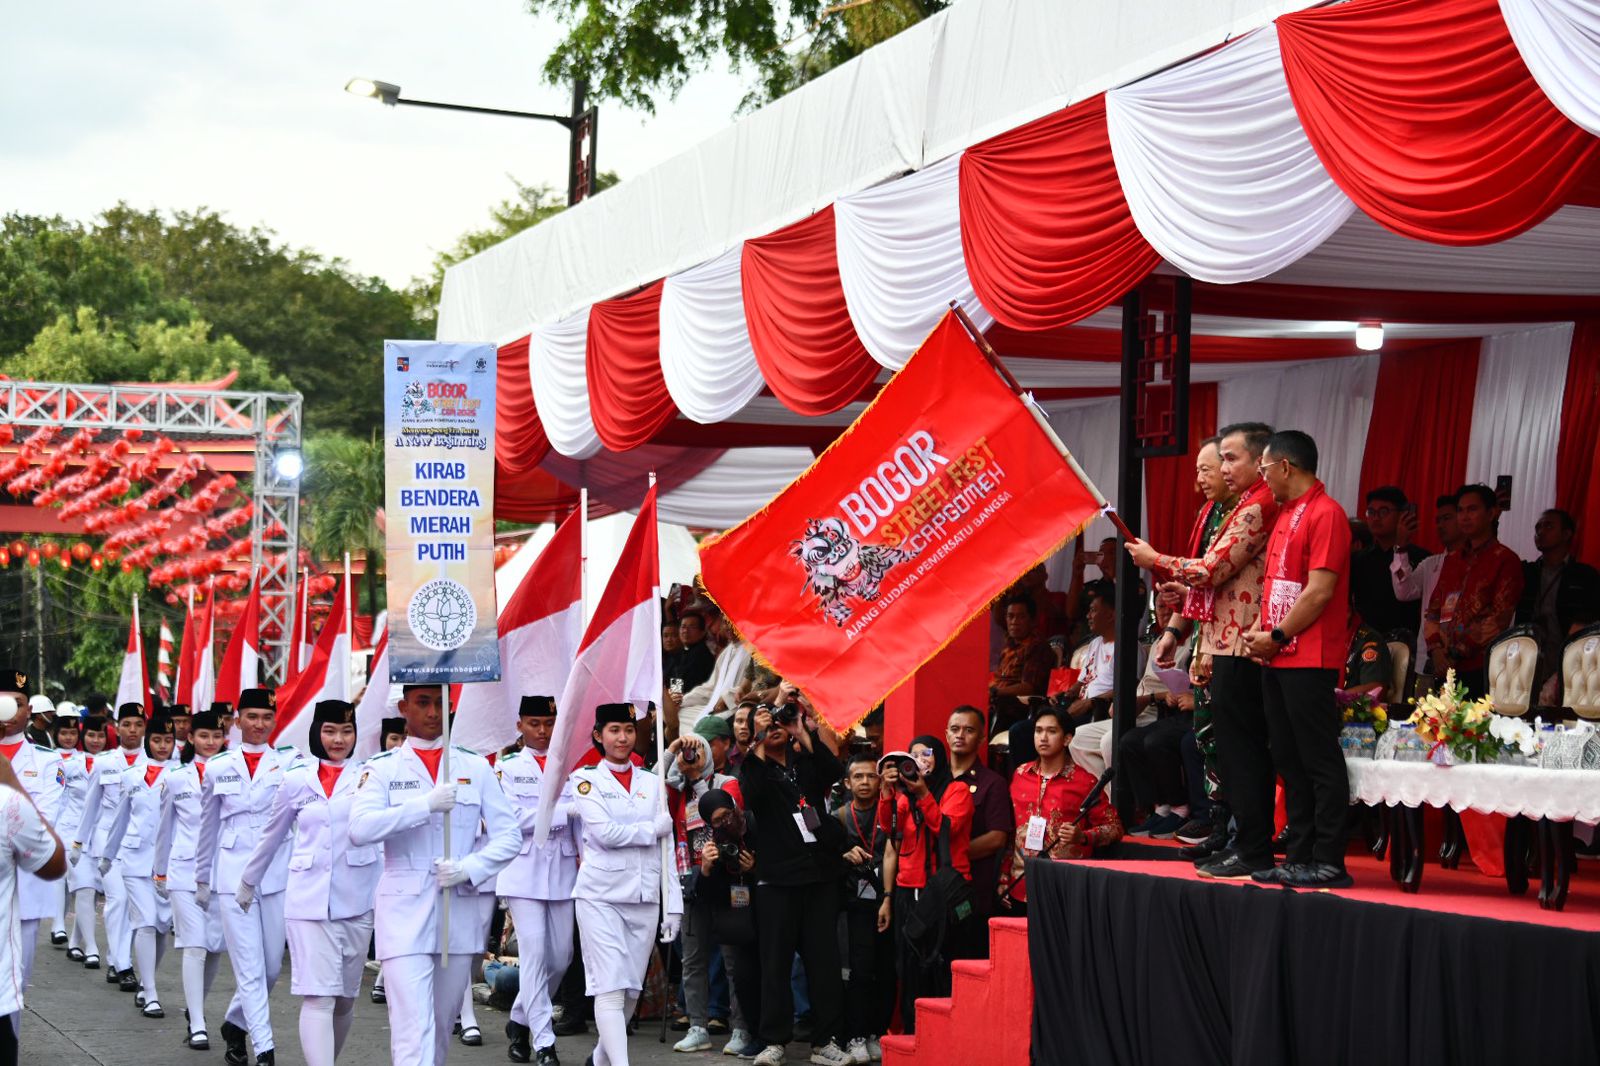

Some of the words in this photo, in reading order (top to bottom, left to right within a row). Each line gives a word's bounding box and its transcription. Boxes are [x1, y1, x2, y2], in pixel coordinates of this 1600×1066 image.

[428, 383, 467, 399] BOGOR
[434, 436, 487, 450] Beginning
[415, 463, 465, 479] KIRAB
[838, 430, 950, 537] BOGOR
[880, 476, 950, 548] STREET
[945, 436, 995, 488] FEST
[401, 489, 480, 507] BENDERA
[909, 460, 1006, 553] CAPGOMEH
[410, 516, 470, 534] MERAH
[417, 543, 465, 561] PUTIH
[844, 607, 880, 640] AJANG
[879, 574, 919, 610] BUDAYA
[916, 524, 974, 577] PEMERSATU
[972, 491, 1013, 528] BANGSA
[420, 634, 440, 647] KOTA
[443, 634, 466, 648] BOGOR
